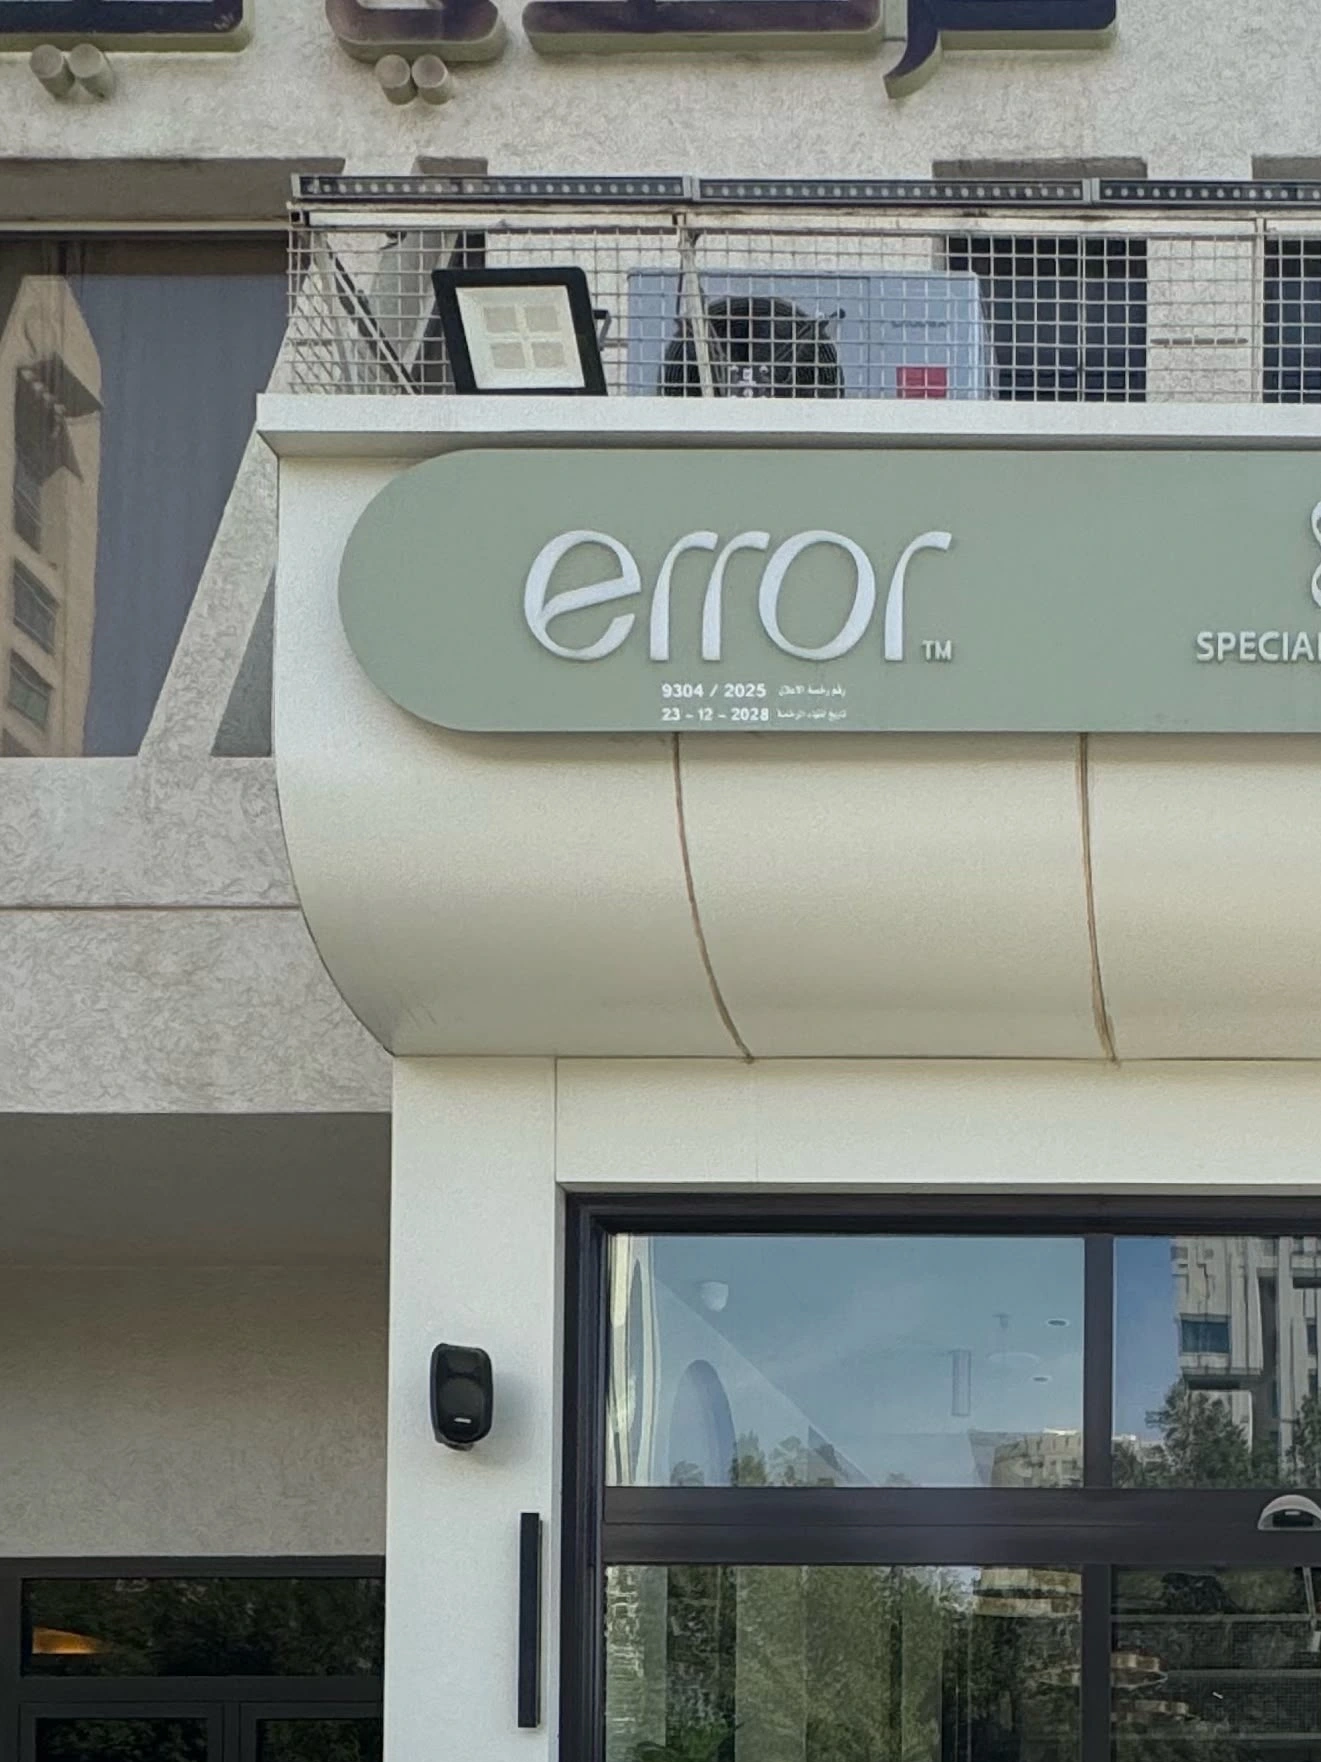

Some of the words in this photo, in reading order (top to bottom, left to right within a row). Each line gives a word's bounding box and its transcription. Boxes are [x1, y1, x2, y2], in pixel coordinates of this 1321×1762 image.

[523, 530, 952, 662] error
[923, 641, 952, 660] TM
[661, 683, 704, 698] 9304
[723, 683, 767, 698] 2025
[661, 707, 681, 721] 23
[698, 707, 713, 721] 12
[731, 707, 769, 721] 2028
